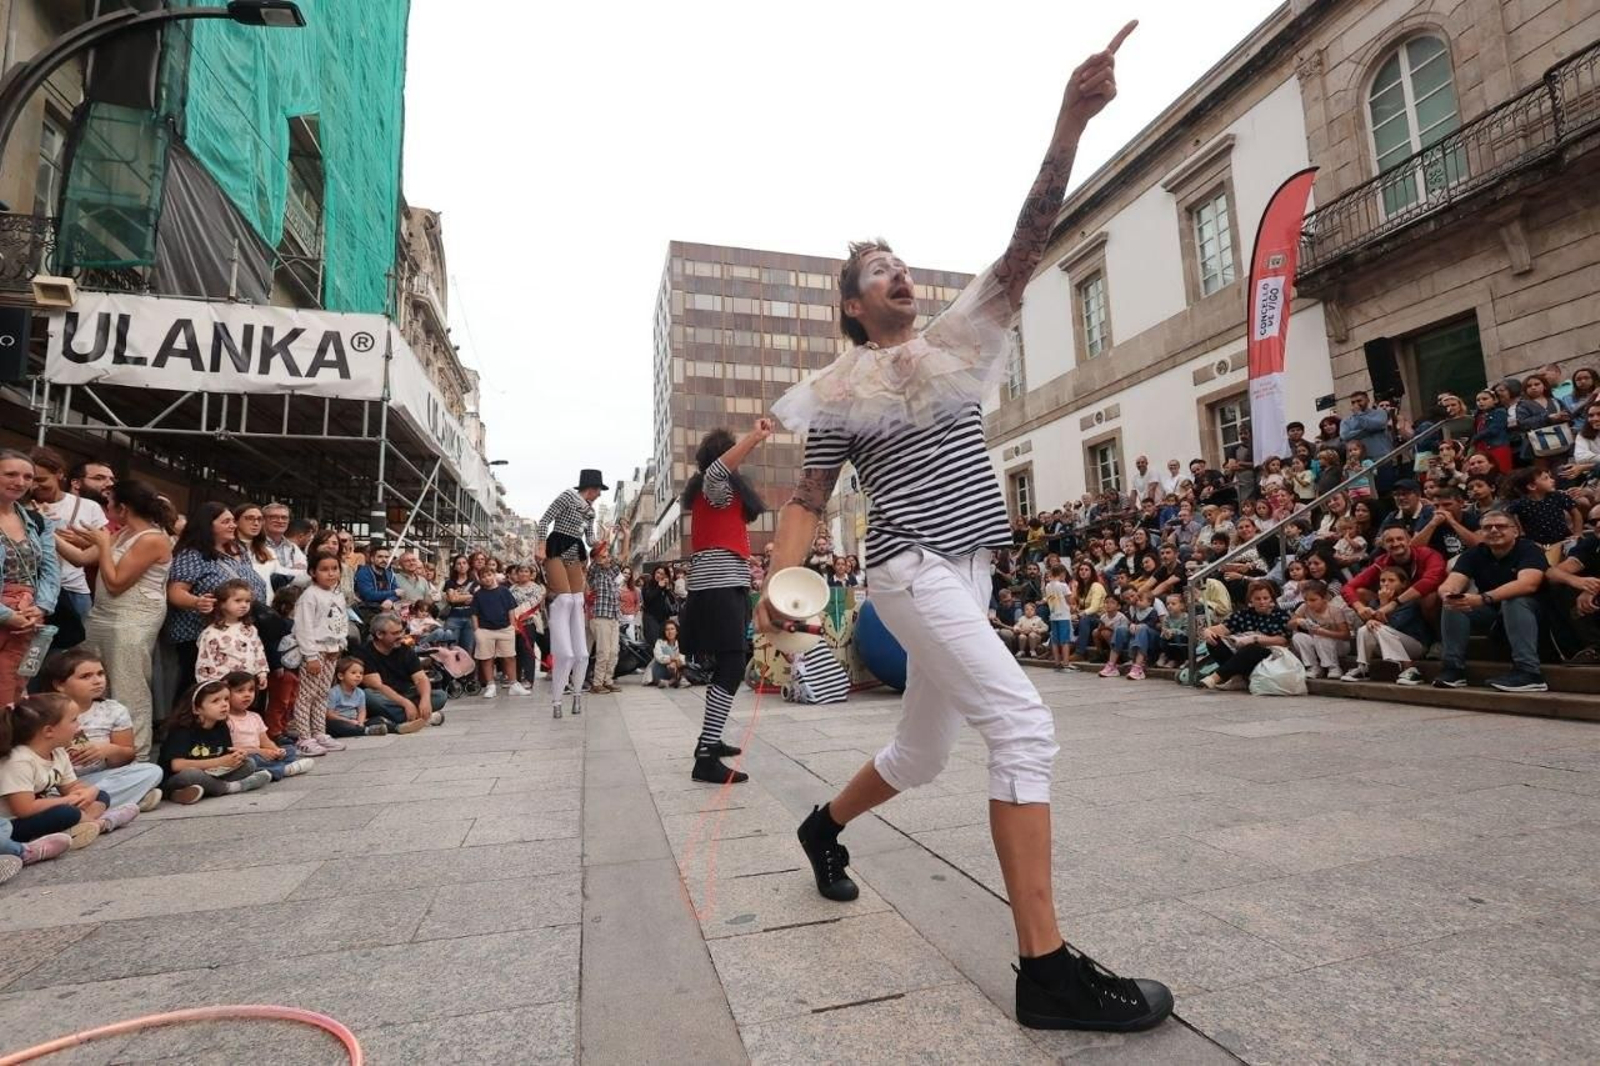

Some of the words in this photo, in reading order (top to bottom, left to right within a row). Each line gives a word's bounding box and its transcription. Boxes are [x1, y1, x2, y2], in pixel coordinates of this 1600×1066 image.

[1260, 283, 1270, 336] CONCELLO
[1269, 287, 1279, 311] VIGO
[1268, 314, 1275, 327] DE
